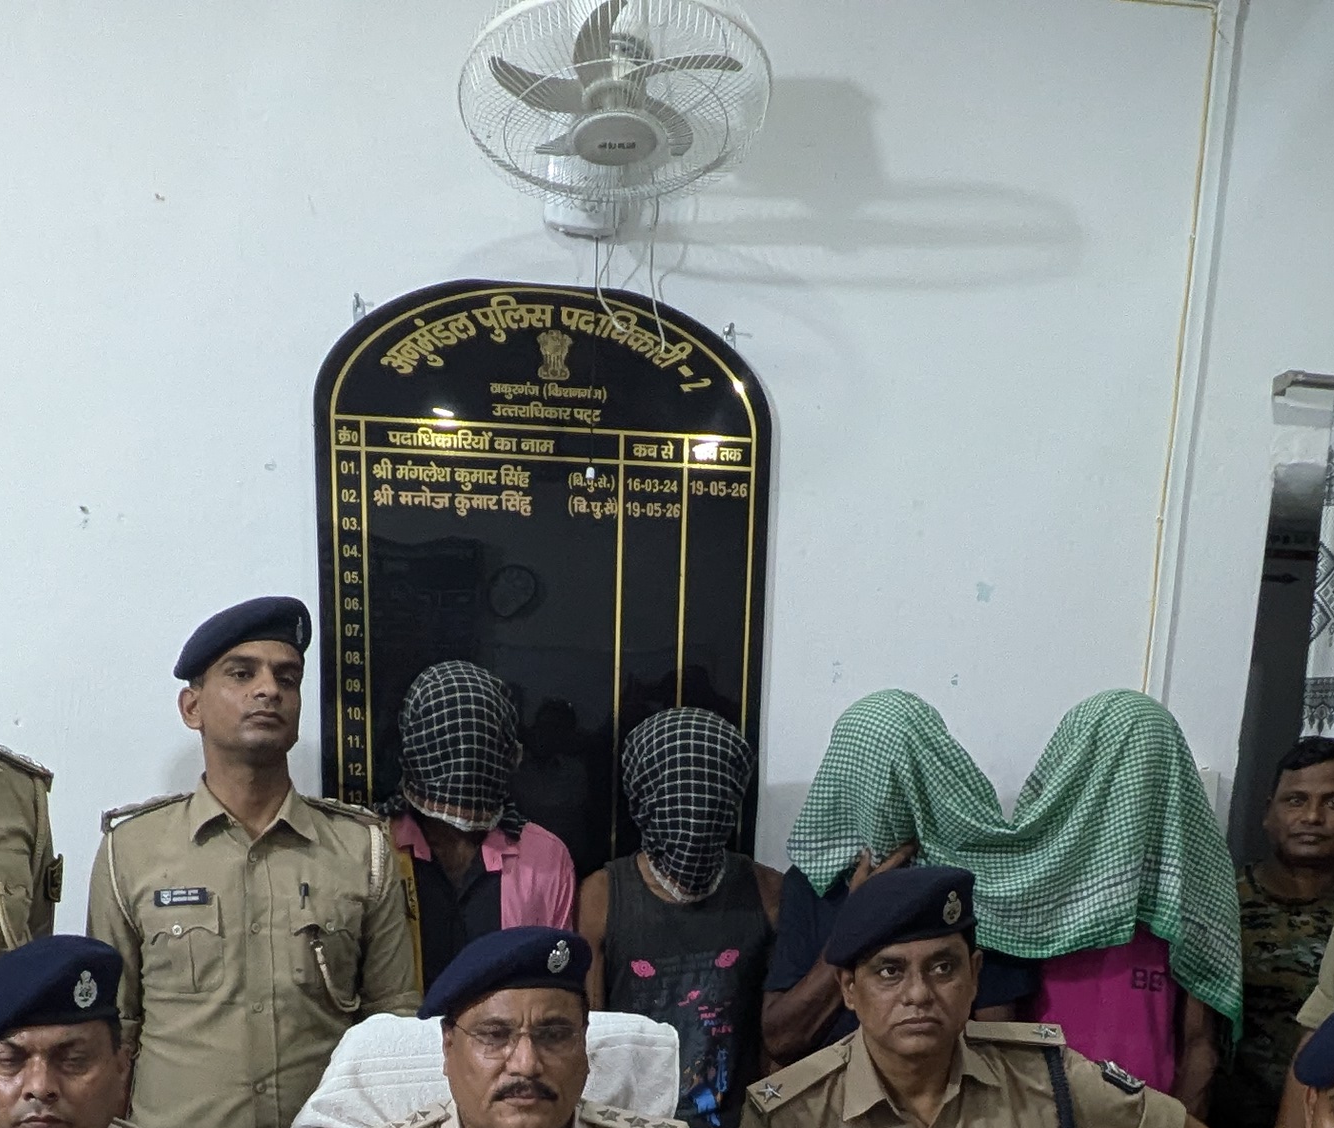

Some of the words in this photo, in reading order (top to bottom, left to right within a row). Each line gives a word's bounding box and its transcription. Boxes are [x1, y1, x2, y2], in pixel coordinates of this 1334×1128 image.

[380, 311, 476, 374] अनुमंडल
[471, 295, 555, 343] पुलिस
[560, 306, 693, 370] पदाधिकारी
[492, 401, 571, 420] उत्तराधिकार
[387, 427, 493, 450] पदाधिकारियों
[494, 436, 517, 452] का
[520, 439, 555, 453] नाम
[660, 440, 674, 459] से
[719, 447, 743, 461] तक
[340, 461, 359, 474] 01.
[372, 457, 392, 479] श्री
[395, 460, 451, 482] मंगलेश
[454, 467, 498, 491] कुमार
[499, 464, 531, 487] सिंह
[627, 478, 678, 493] 16-03-24
[689, 480, 748, 497] 19-05-26
[341, 489, 360, 503] 02.
[373, 483, 394, 506] श्री
[398, 486, 452, 508] मनोज
[454, 492, 498, 516] कुमार
[500, 490, 532, 516] सिंह
[626, 502, 681, 518] 19-05-26
[342, 518, 361, 531] 03.
[343, 545, 361, 558] 04.
[344, 571, 362, 584] 05.
[344, 598, 363, 611] 06.
[345, 624, 363, 637] 07.
[345, 652, 364, 665] 08.
[346, 679, 364, 693] 09.
[347, 707, 365, 721] 10.
[347, 735, 365, 749] 11.
[348, 762, 366, 776] 12.
